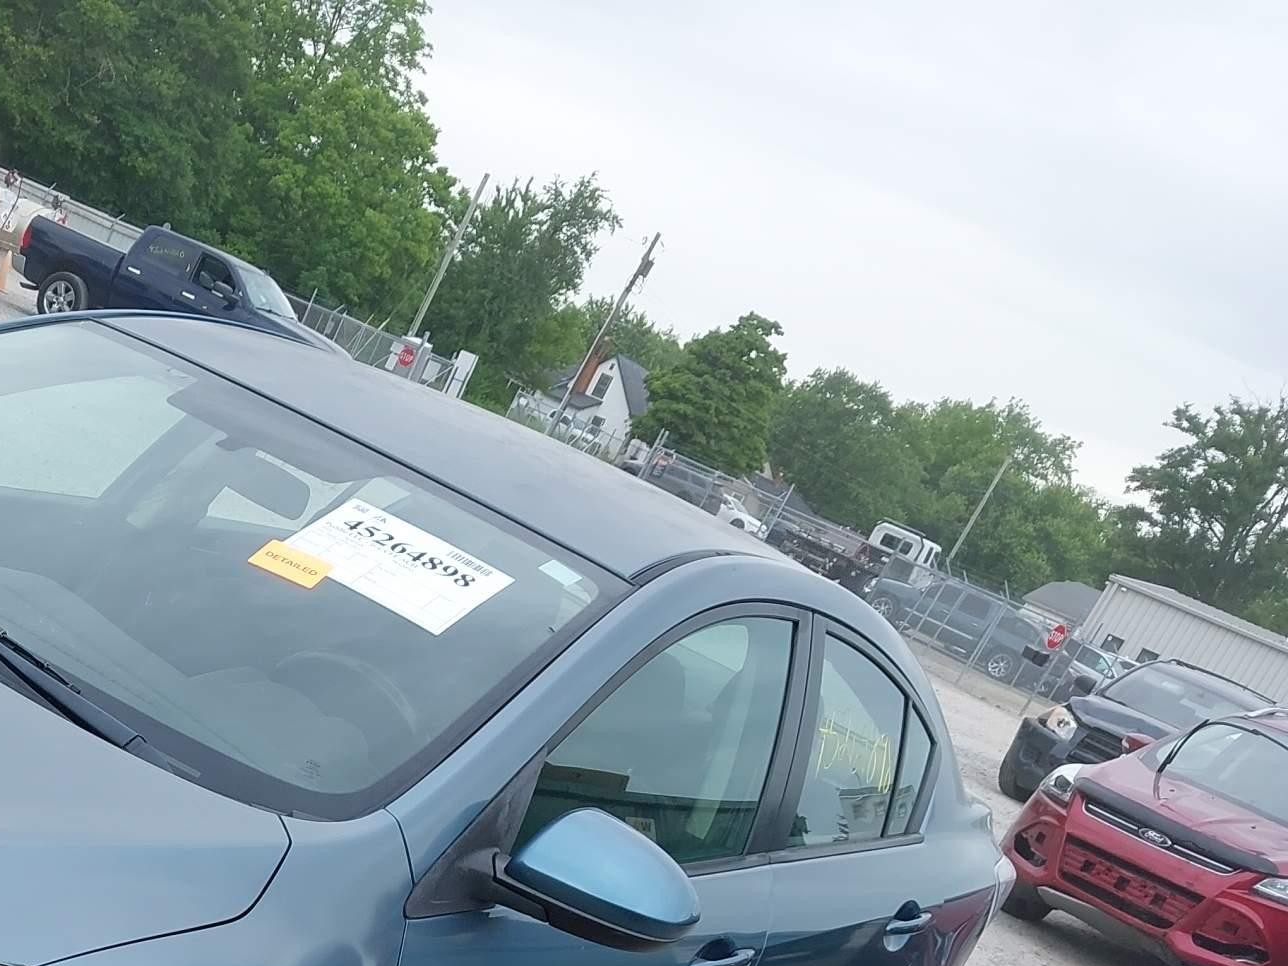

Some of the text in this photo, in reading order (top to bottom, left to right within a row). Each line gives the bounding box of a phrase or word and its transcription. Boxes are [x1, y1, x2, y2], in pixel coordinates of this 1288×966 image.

[400, 351, 414, 362] STOP
[265, 551, 318, 576] DETAILED
[343, 520, 477, 588] 45264898
[1048, 630, 1064, 643] STOP
